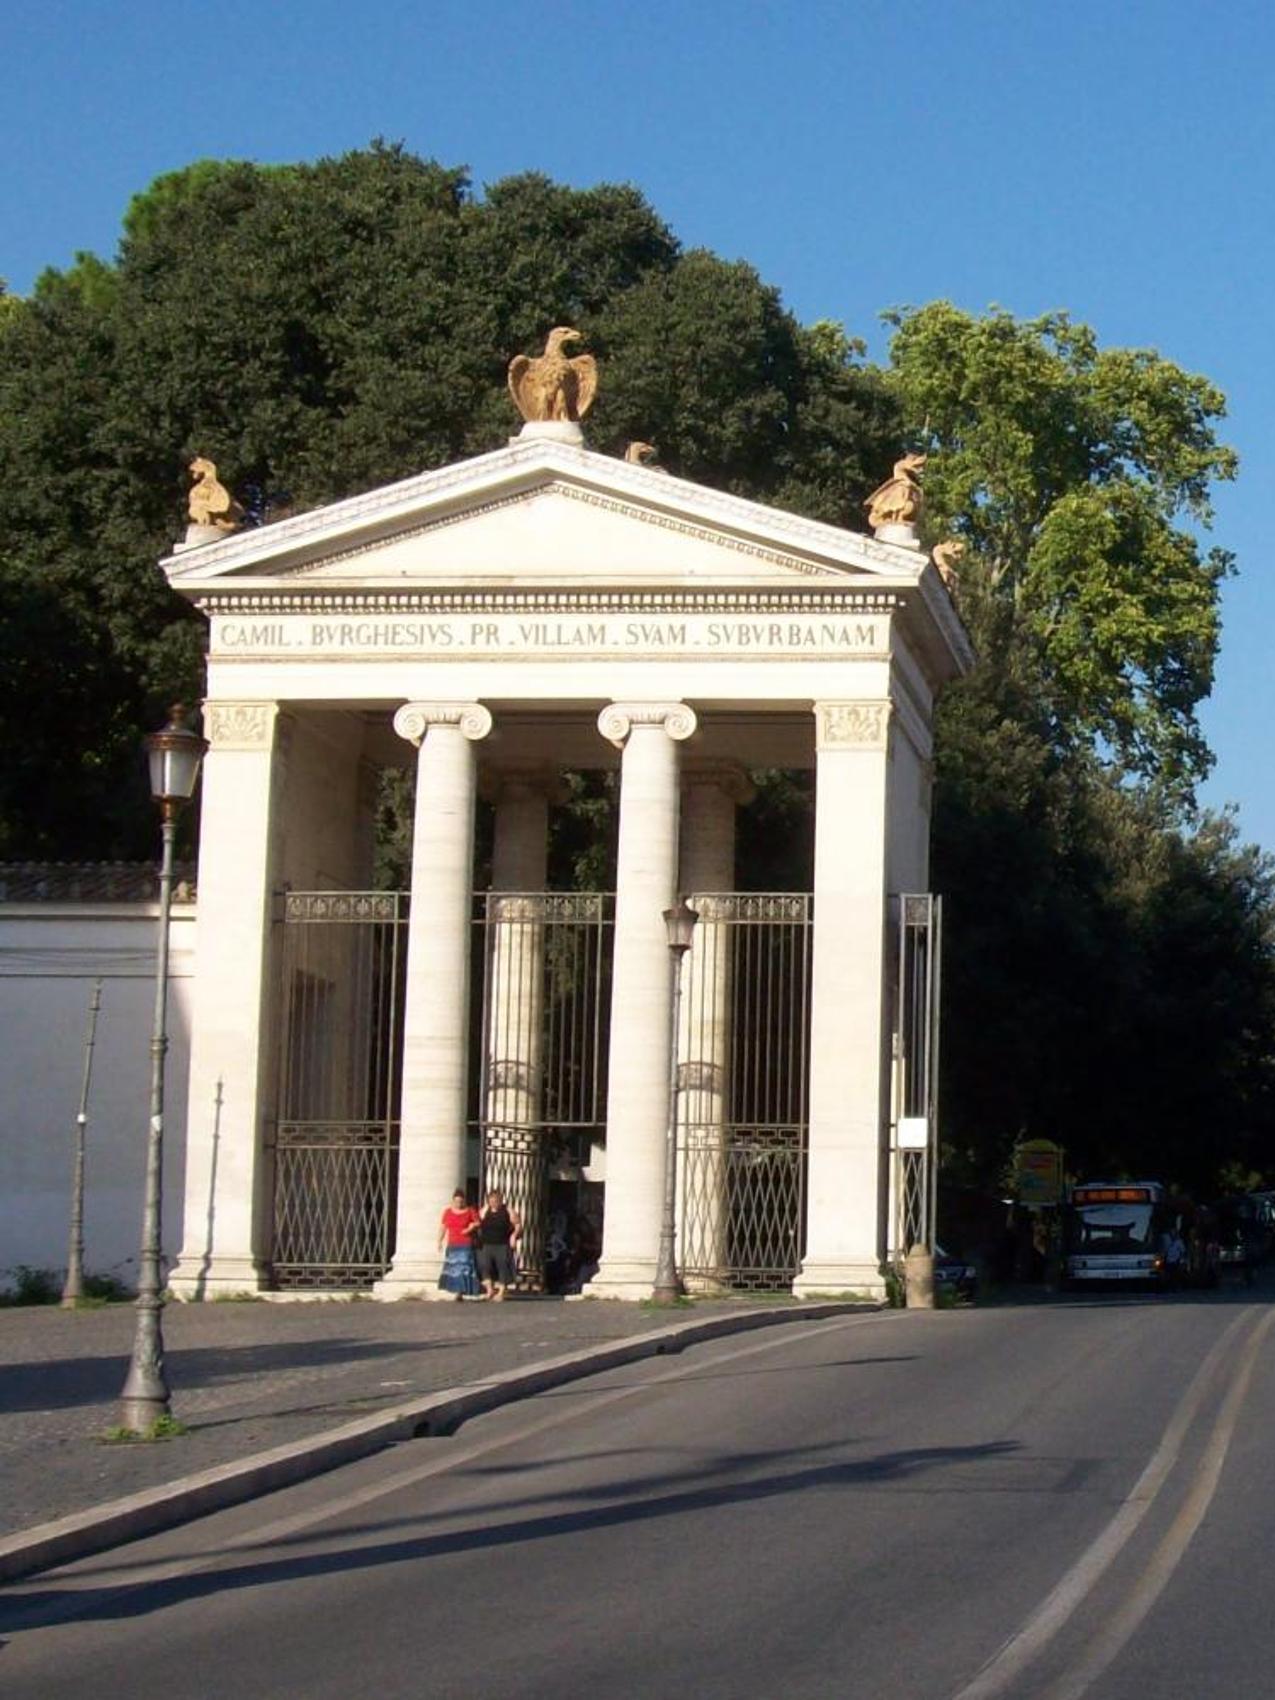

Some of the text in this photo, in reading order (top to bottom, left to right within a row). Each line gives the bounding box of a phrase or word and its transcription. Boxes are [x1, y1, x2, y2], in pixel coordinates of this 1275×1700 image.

[220, 624, 291, 647] CAMIL
[311, 623, 453, 647] BVRGHESIVS
[519, 623, 607, 646] VILLAM
[625, 623, 687, 646] SVAM
[707, 623, 876, 646] SVBVRBANAM
